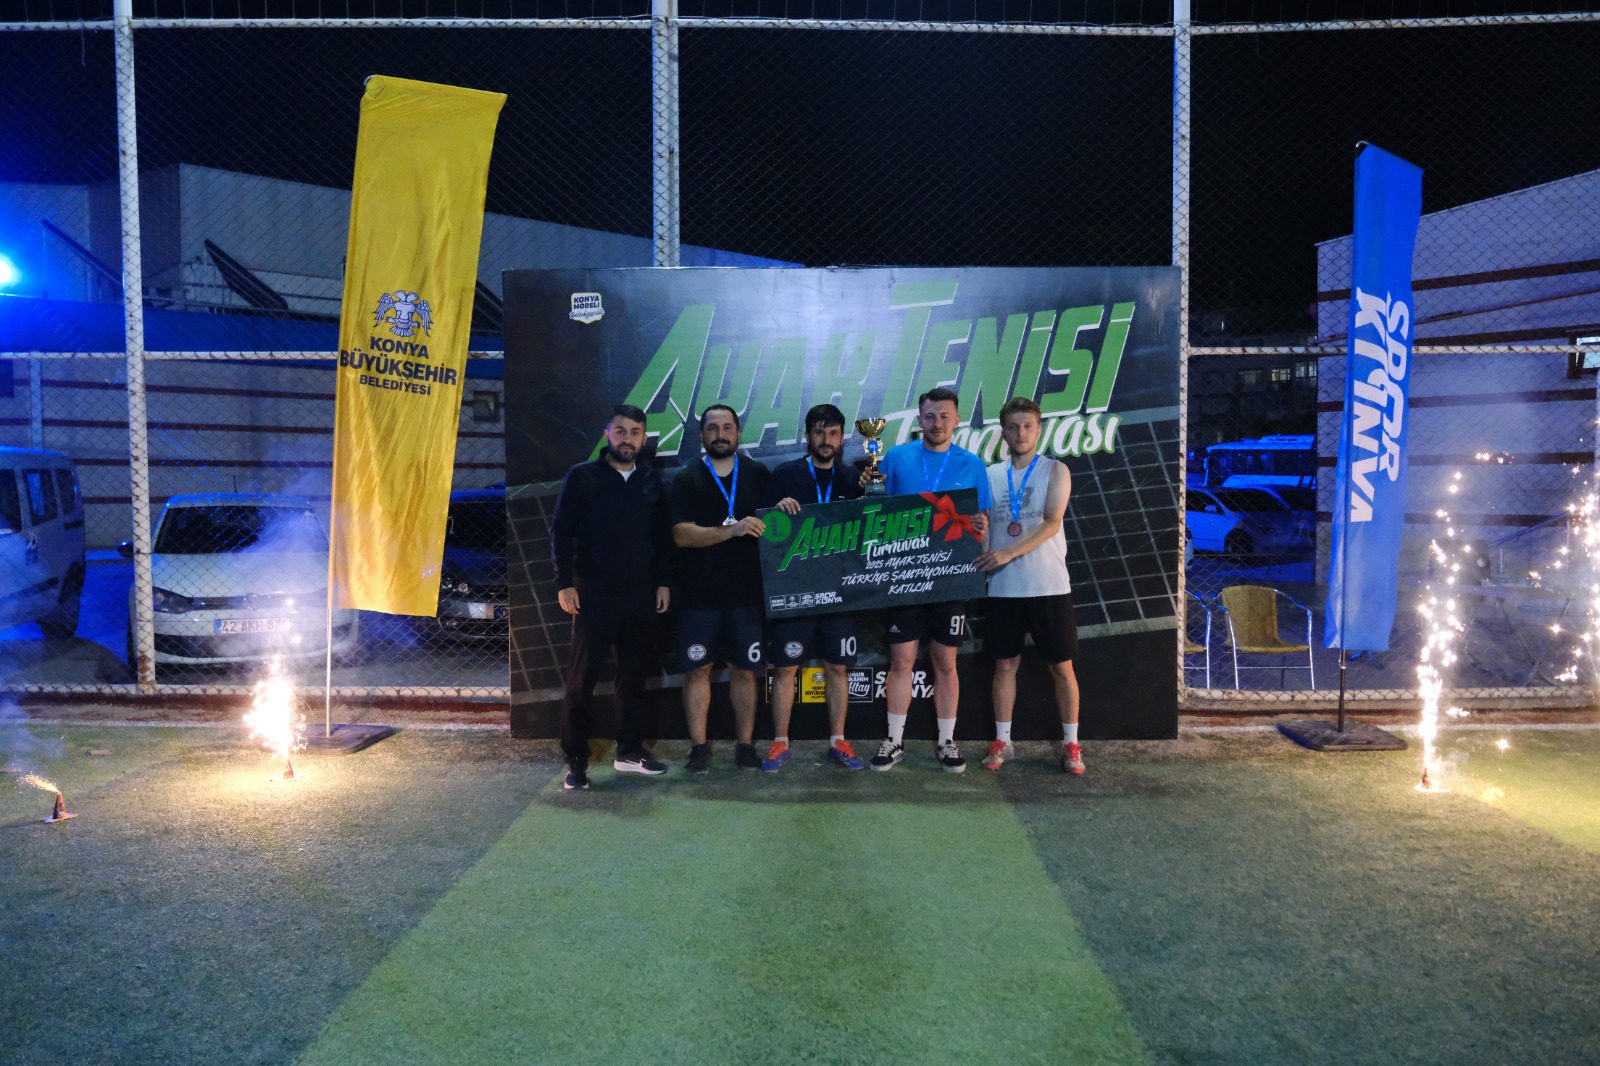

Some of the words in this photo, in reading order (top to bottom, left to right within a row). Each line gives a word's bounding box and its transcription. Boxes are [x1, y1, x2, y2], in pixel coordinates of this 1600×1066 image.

[574, 295, 599, 303] KONYA
[369, 336, 429, 360] KONYA
[339, 347, 458, 386] BÜYÜKŞEHİR
[359, 374, 432, 396] BELEDİYESİ
[1379, 290, 1409, 483] SPOR
[1350, 286, 1389, 523] KONYA
[1006, 510, 1042, 523] bance
[777, 516, 861, 572] AYAK
[863, 536, 930, 562] Turnuvası
[865, 560, 885, 570] 2025
[885, 555, 916, 570] AYAK
[916, 549, 953, 565] TENİSİ
[841, 571, 890, 586] TÜRKİYE
[815, 591, 837, 599] SPOR
[815, 597, 843, 605] KONYA
[221, 620, 238, 632] 42
[241, 620, 263, 632] AKH
[949, 615, 966, 635] 91
[747, 641, 760, 663] 6
[840, 636, 857, 656] 10
[875, 684, 935, 698] KNYA
